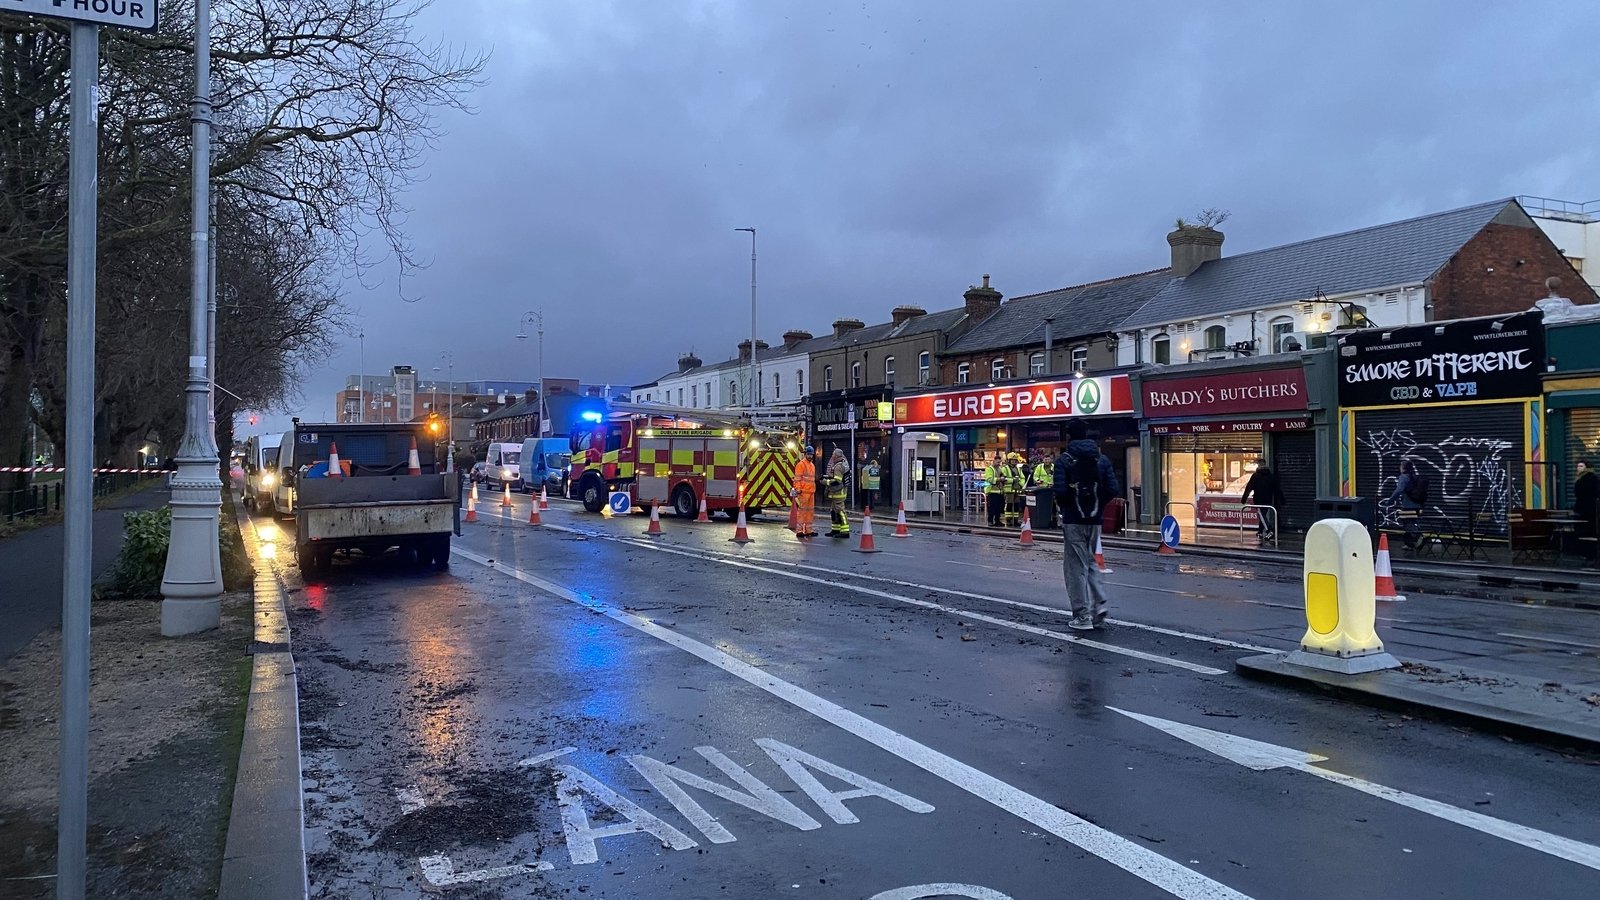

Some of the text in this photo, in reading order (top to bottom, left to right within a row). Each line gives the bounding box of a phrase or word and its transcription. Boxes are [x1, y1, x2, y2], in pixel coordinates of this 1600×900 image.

[73, 0, 144, 19] HOUR
[1345, 348, 1532, 383] SMOKE DIFFERENT
[1150, 383, 1298, 407] BRADY'S BUTCHERS
[1390, 381, 1477, 400] CBD & VAPE
[933, 387, 1070, 418] EUROSPAR
[1154, 426, 1169, 434] BEEF
[1232, 423, 1263, 431] POULTRY
[1285, 421, 1306, 429] LAMB
[1205, 510, 1227, 518] MASTER
